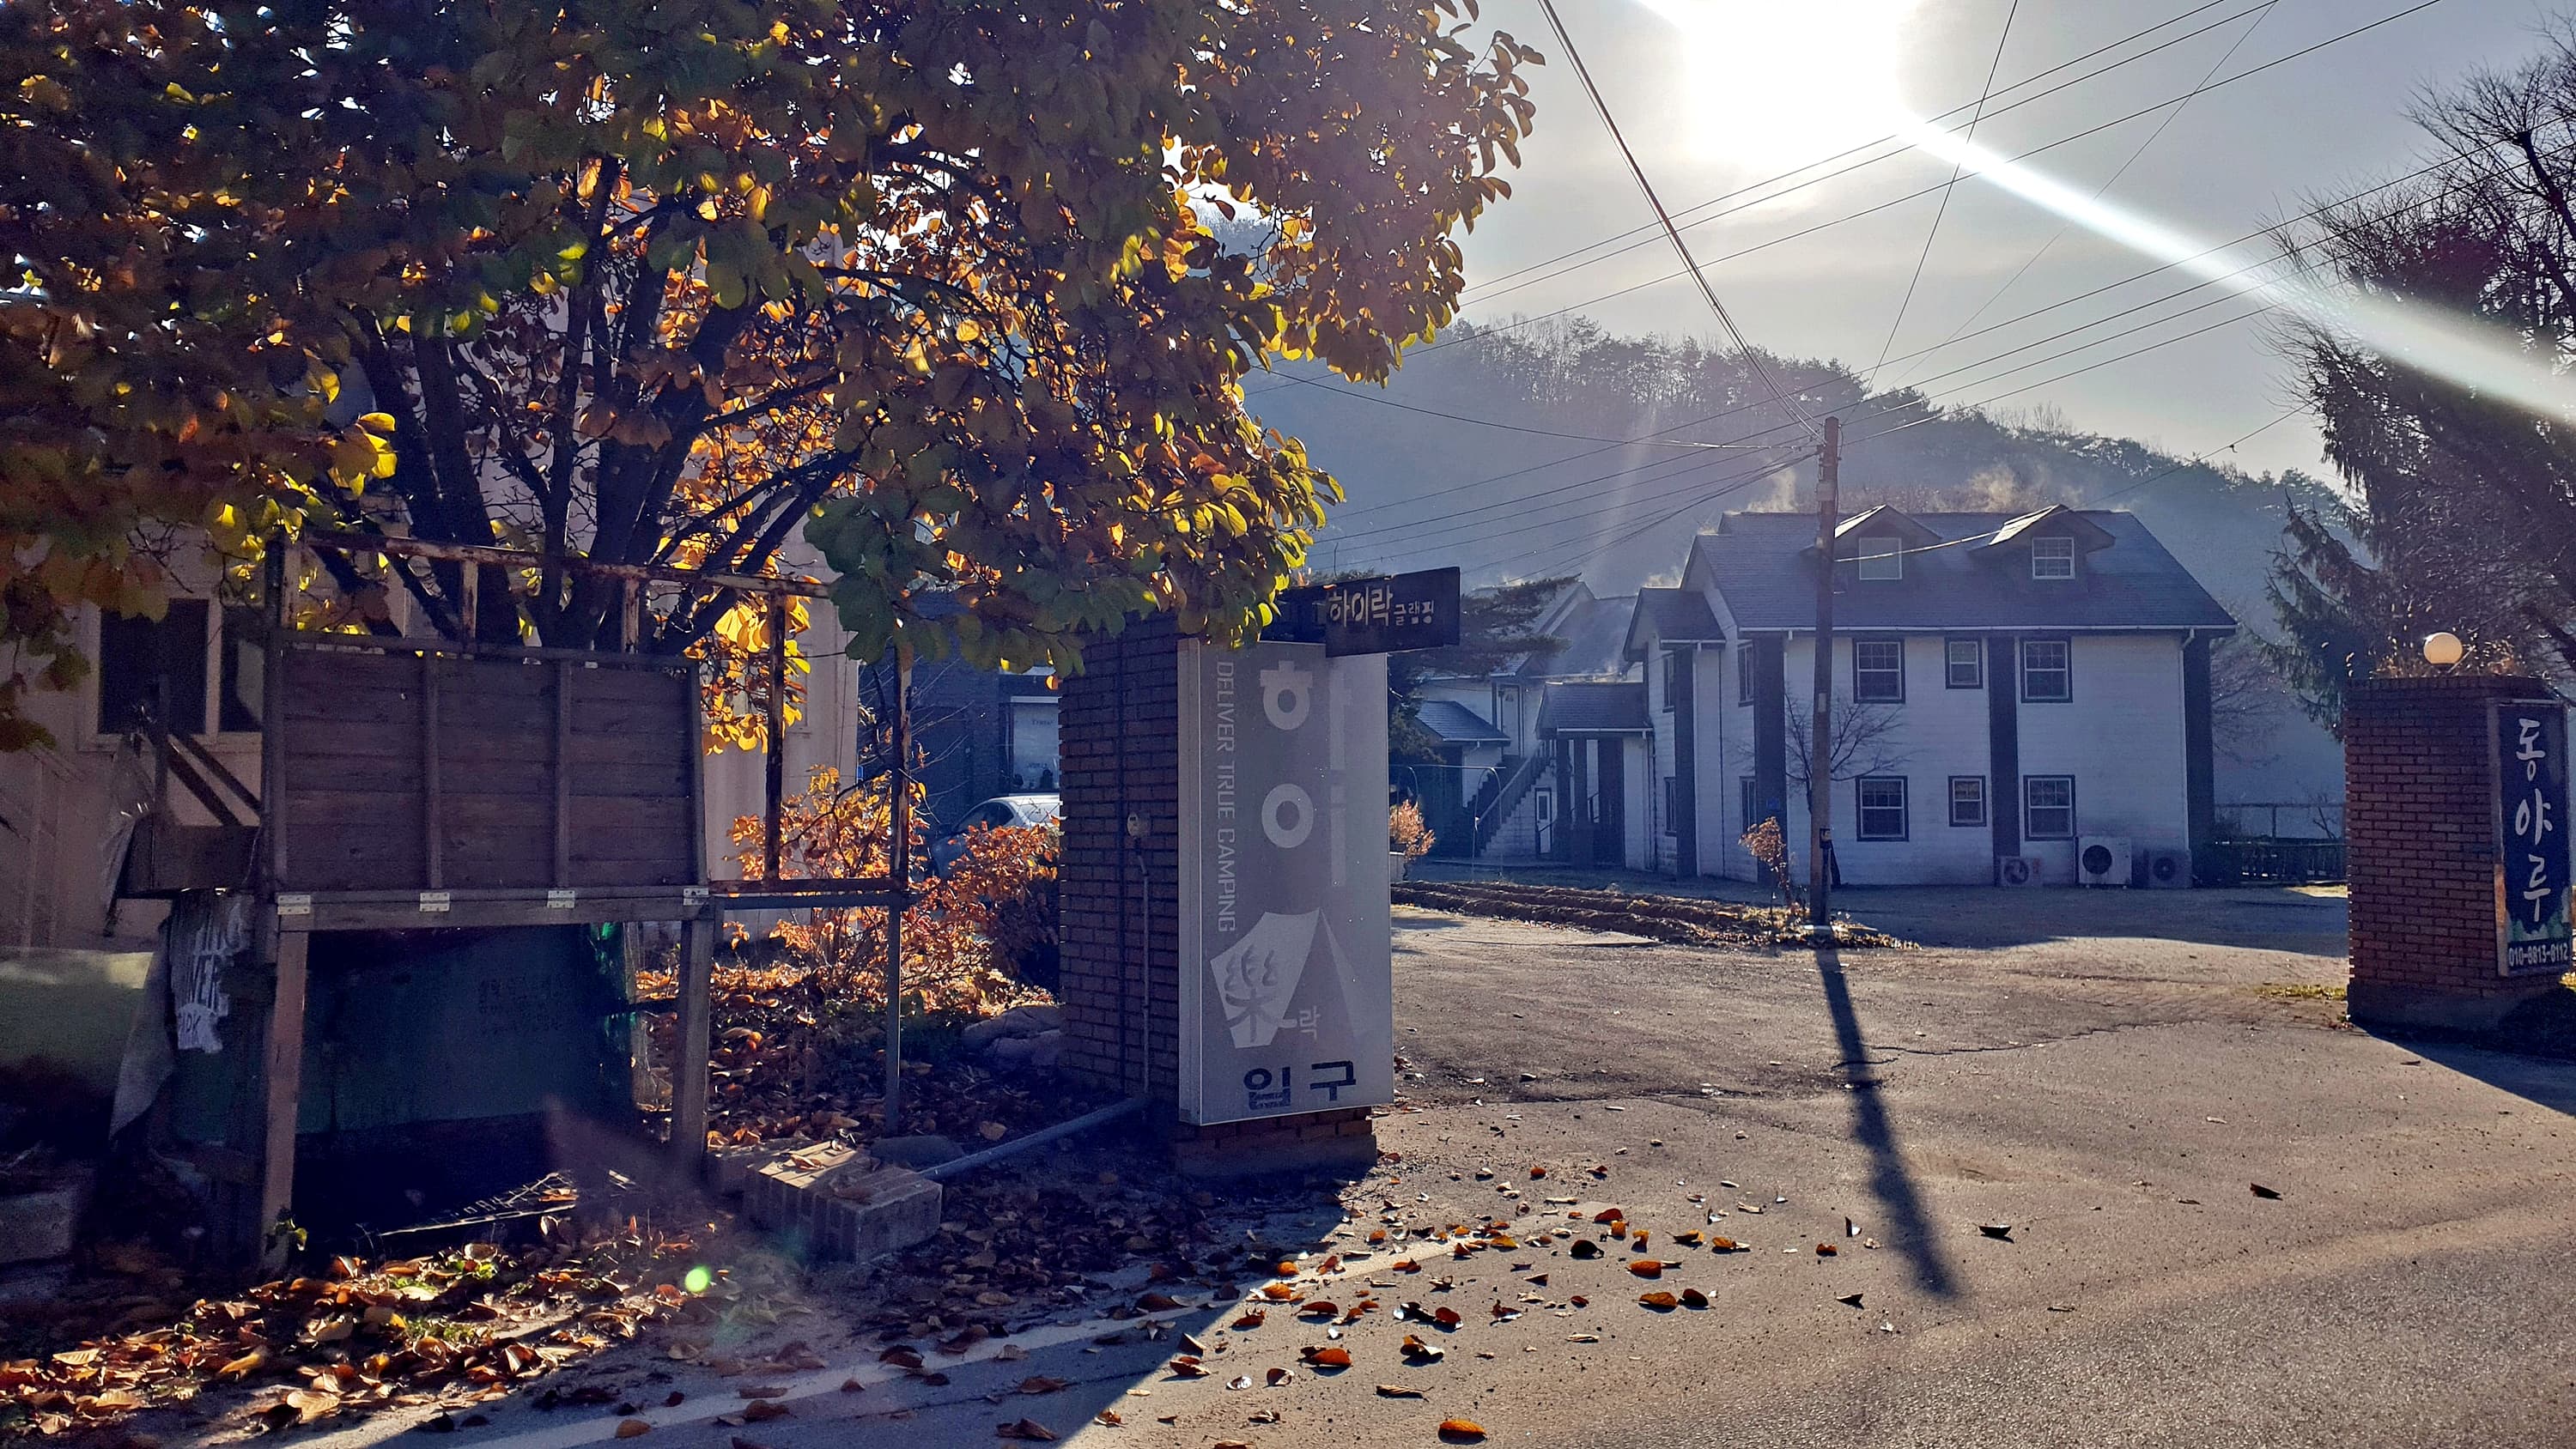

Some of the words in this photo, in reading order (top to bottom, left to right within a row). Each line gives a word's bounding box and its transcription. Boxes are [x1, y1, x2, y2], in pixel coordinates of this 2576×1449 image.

[1329, 585, 1394, 627] 하이락
[1216, 661, 1235, 752] DELIVER
[1217, 761, 1236, 819] TRUE
[2516, 718, 2553, 922] 동야루
[1218, 828, 1236, 932] CAMPING
[1243, 1059, 1357, 1110] 입구
